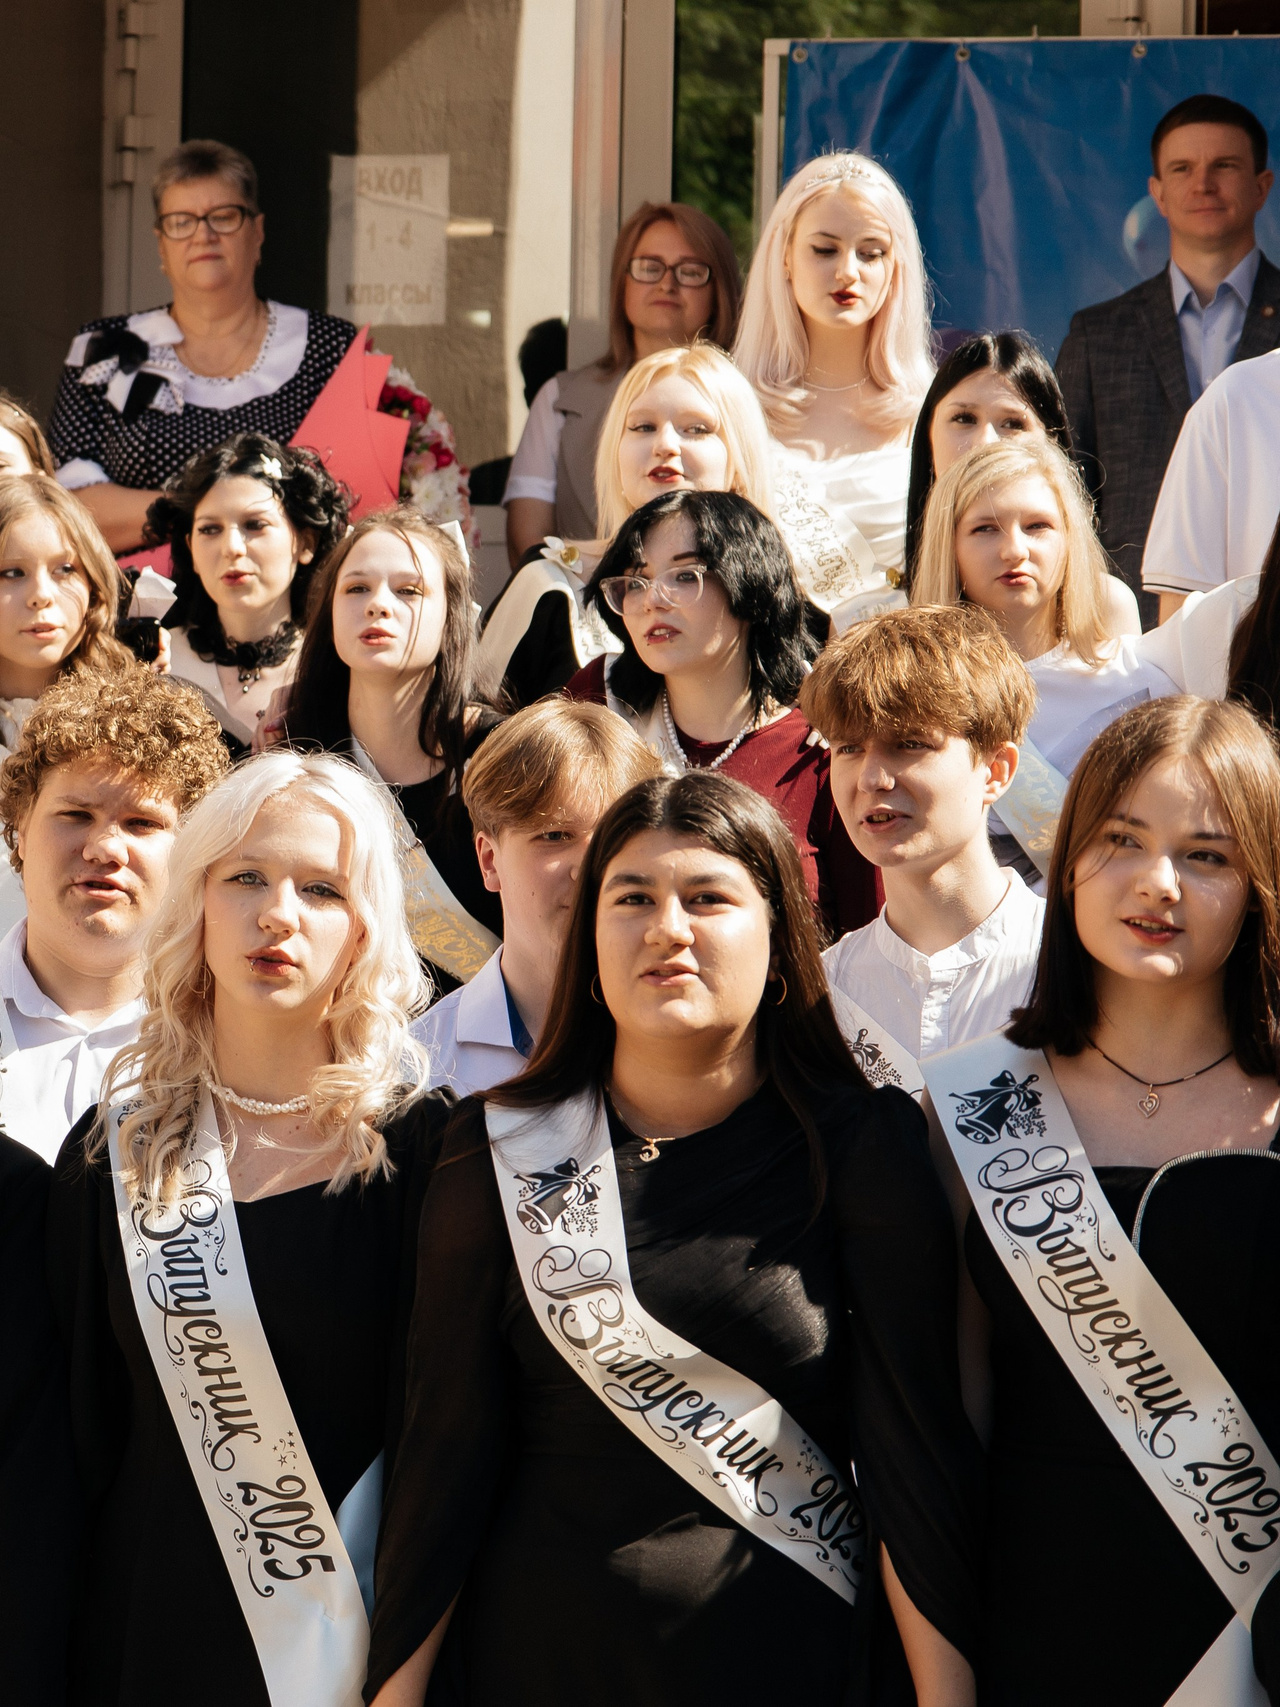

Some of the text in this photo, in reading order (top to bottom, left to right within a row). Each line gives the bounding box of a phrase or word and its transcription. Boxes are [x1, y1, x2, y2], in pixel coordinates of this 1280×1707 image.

[138, 1158, 336, 1582] Выпускник 2025
[532, 1245, 866, 1572] Выпускник 202
[978, 1145, 1280, 1553] Выпускник 2025
